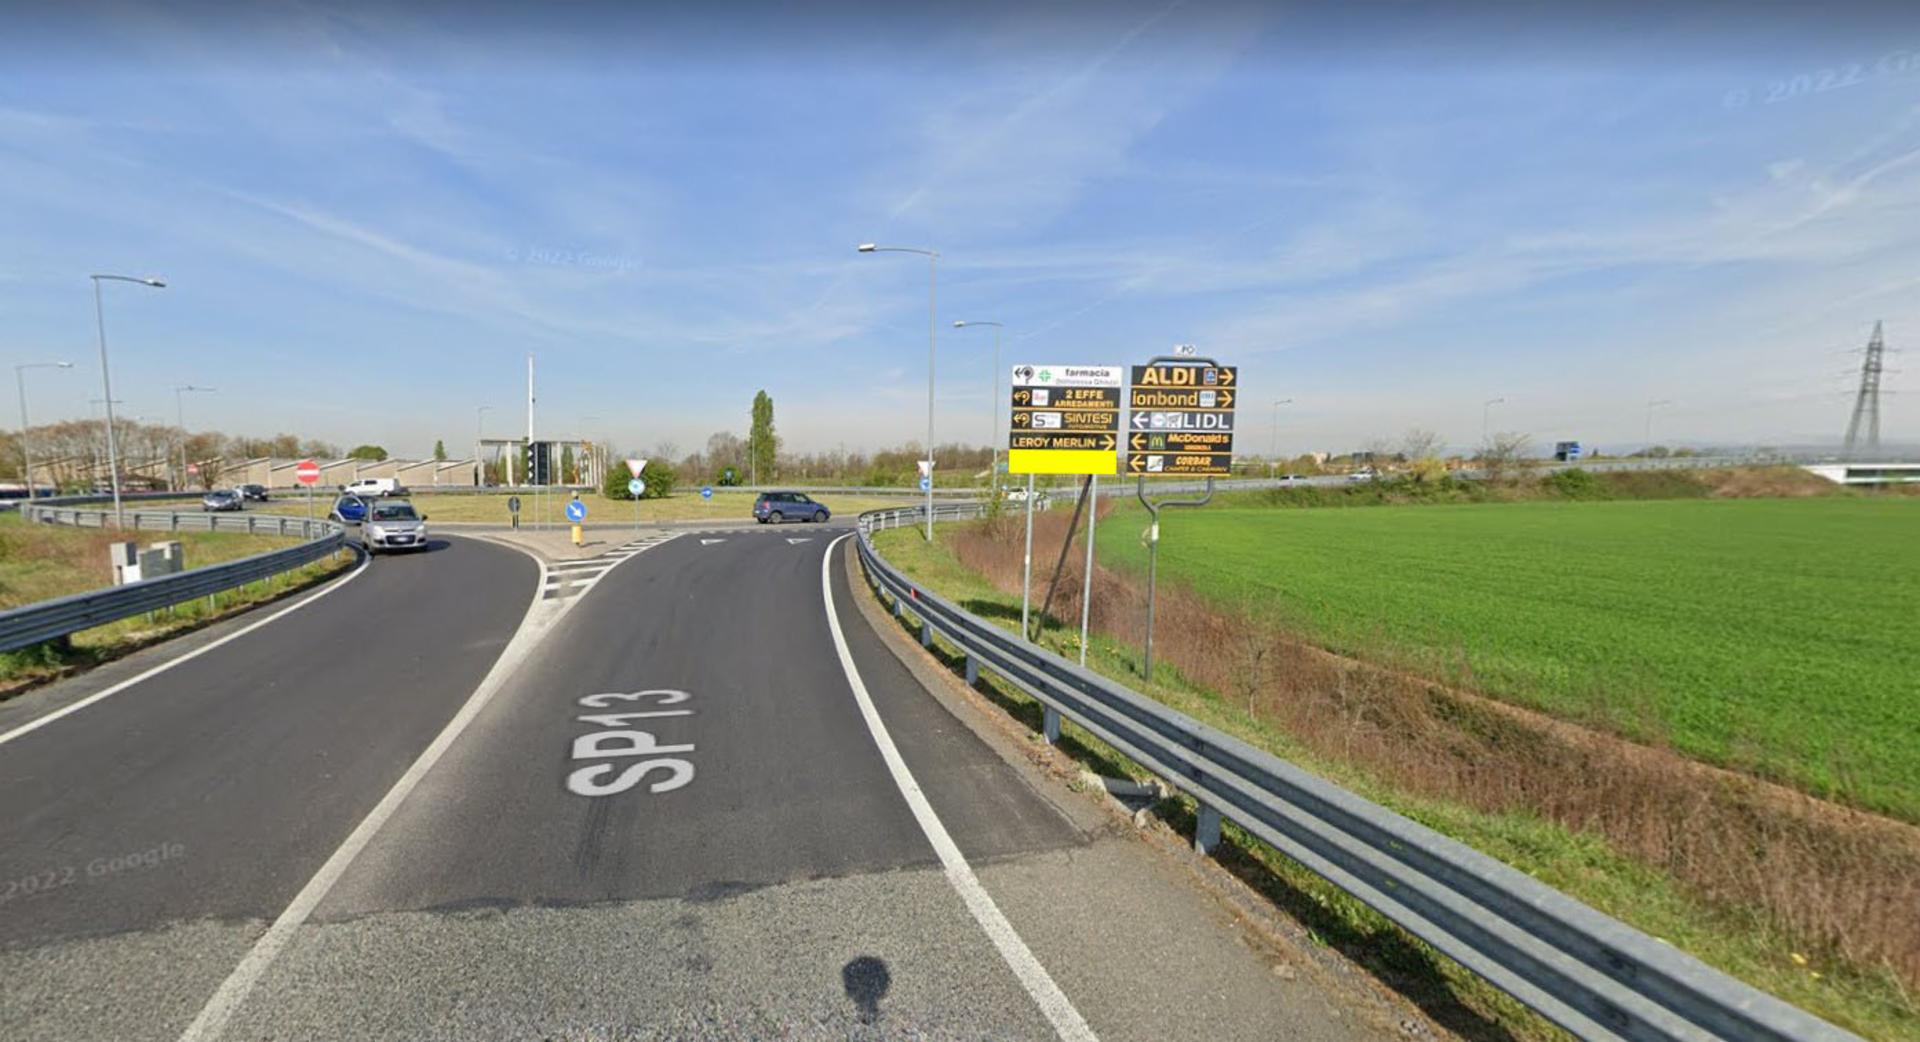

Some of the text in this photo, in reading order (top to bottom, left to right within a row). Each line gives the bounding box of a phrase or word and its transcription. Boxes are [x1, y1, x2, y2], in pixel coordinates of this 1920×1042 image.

[1065, 368, 1111, 377] farmacia
[1141, 367, 1196, 385] ALDI
[1065, 389, 1104, 399] 2 EFFE
[1132, 390, 1198, 406] ionbond
[1054, 399, 1114, 408] ARREDAMENTI
[1064, 413, 1112, 424] SINTESI
[1184, 413, 1229, 428] LIDL
[1012, 437, 1096, 448] LEROY MERLIN
[567, 689, 696, 797] SP13
